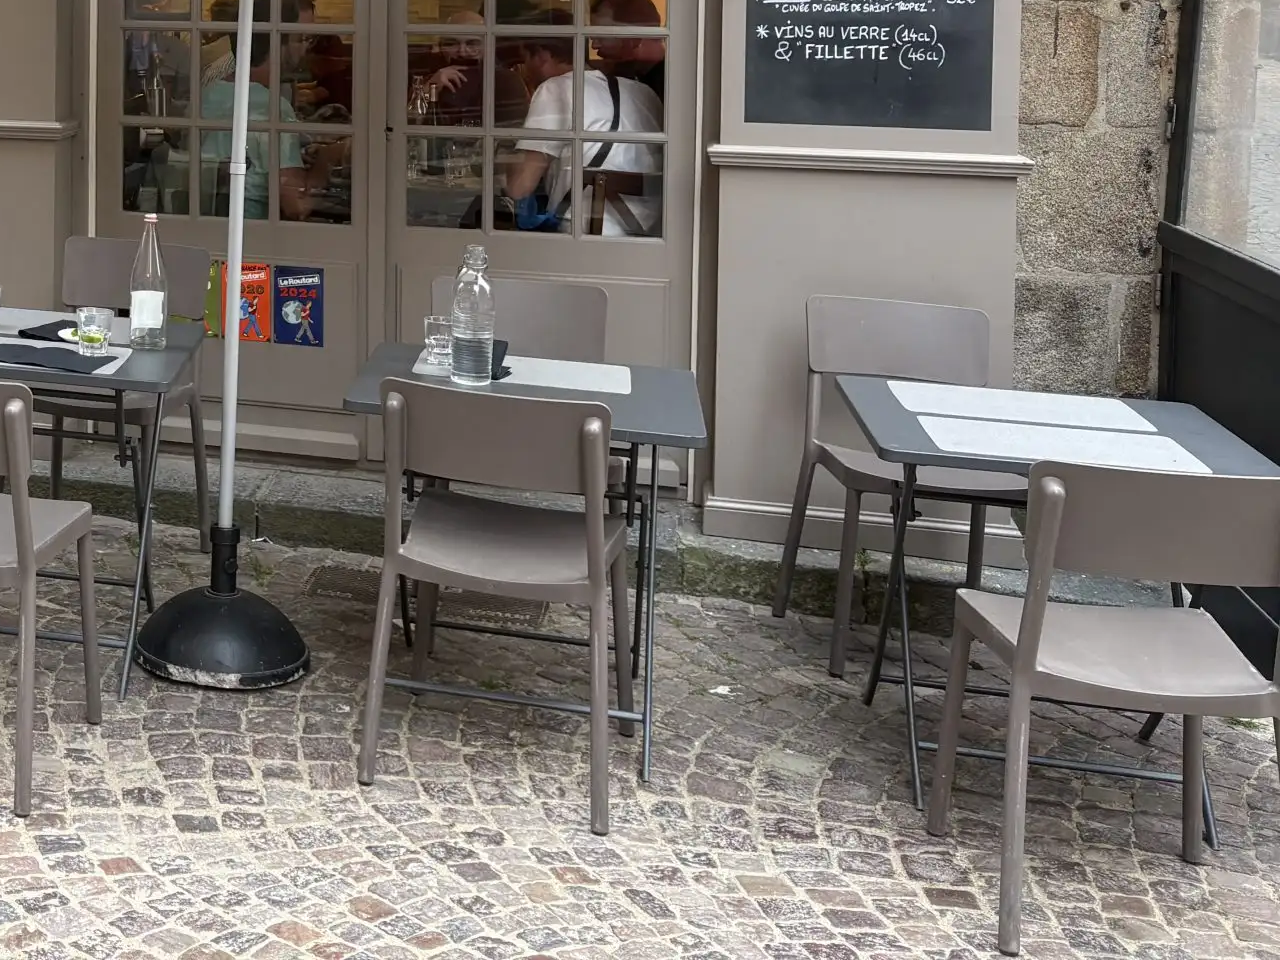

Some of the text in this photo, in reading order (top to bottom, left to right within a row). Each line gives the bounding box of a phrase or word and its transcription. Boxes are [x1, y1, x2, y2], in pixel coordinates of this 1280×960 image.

[812, 3, 822, 11] DU
[824, 1, 850, 12] GOLFE
[851, 3, 862, 11] DE
[774, 19, 938, 46] VINS AU VERRE (14CL)
[774, 41, 792, 61] &
[899, 43, 945, 70] (46CL)
[280, 287, 318, 299] 2024
